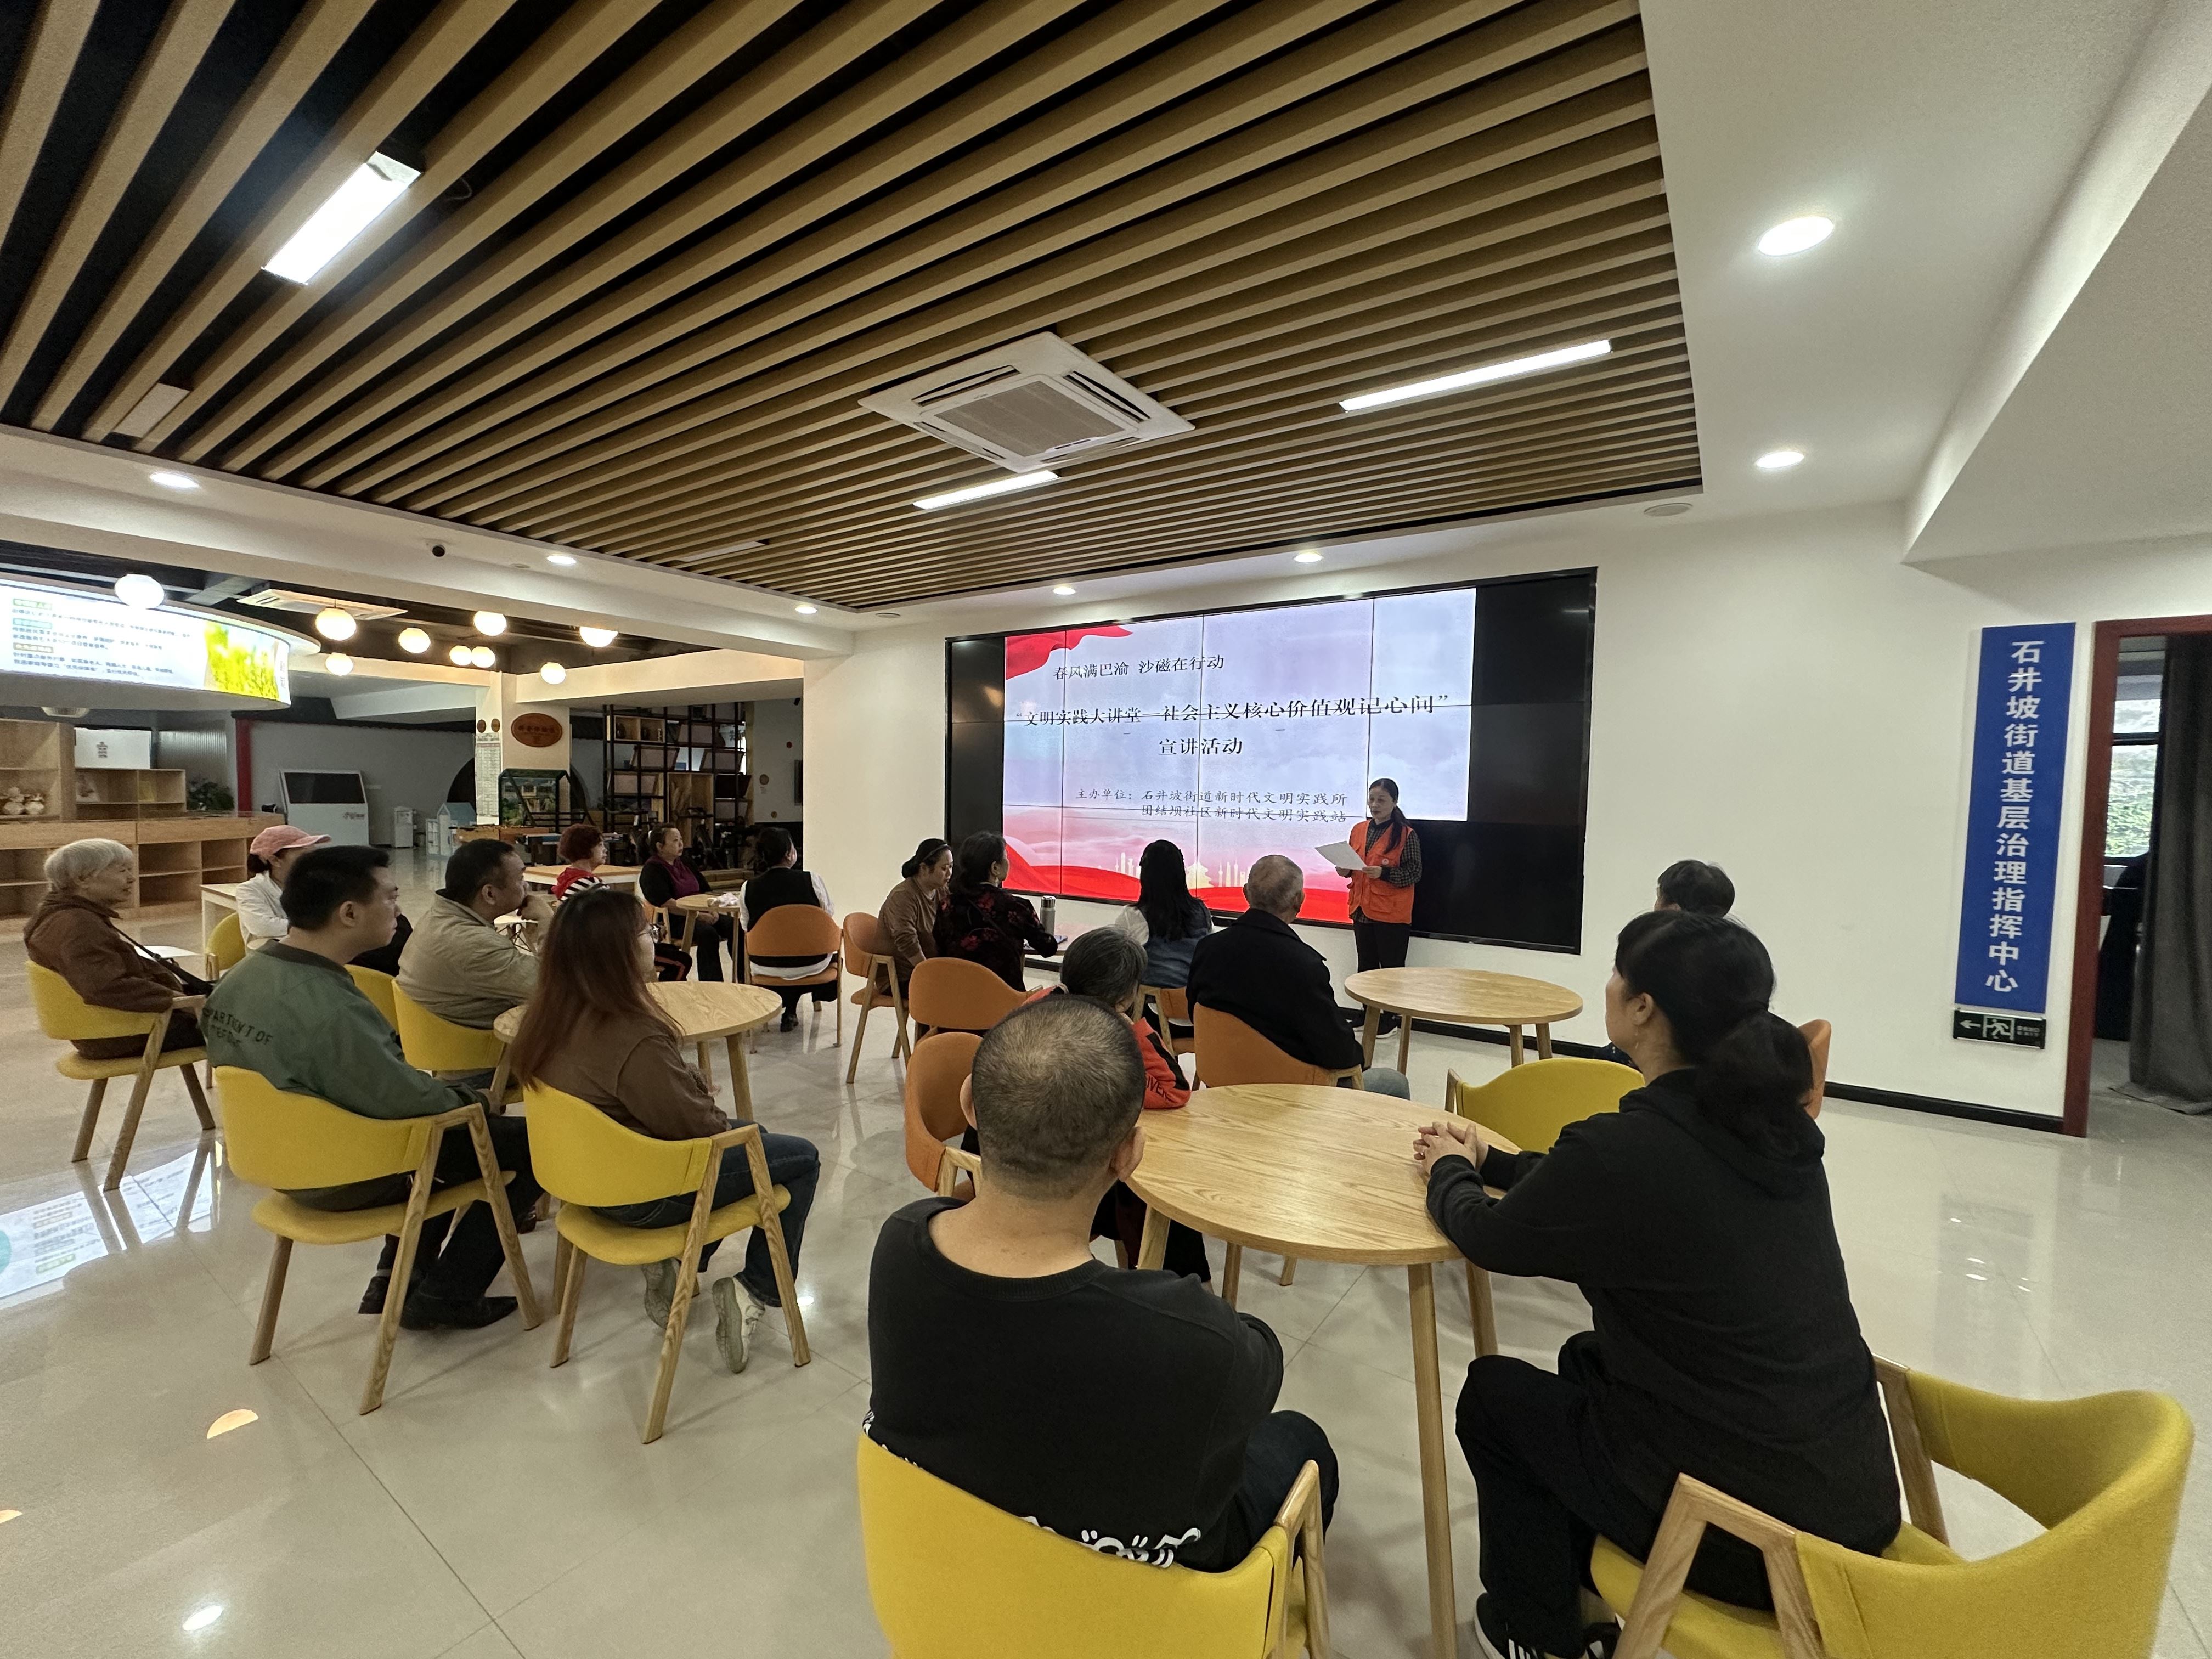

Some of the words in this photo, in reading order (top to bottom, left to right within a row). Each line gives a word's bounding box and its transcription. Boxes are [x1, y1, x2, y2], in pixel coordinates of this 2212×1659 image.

[1053, 662, 1129, 680] 春风满巴渝
[1138, 654, 1224, 674] 沙磁在行动
[1158, 737, 1242, 755] 宣讲活动
[1142, 805, 1346, 823] 团结坝社区新时代文明实践站
[1985, 640, 2046, 993] 石井坡街道基层治理指挥中心
